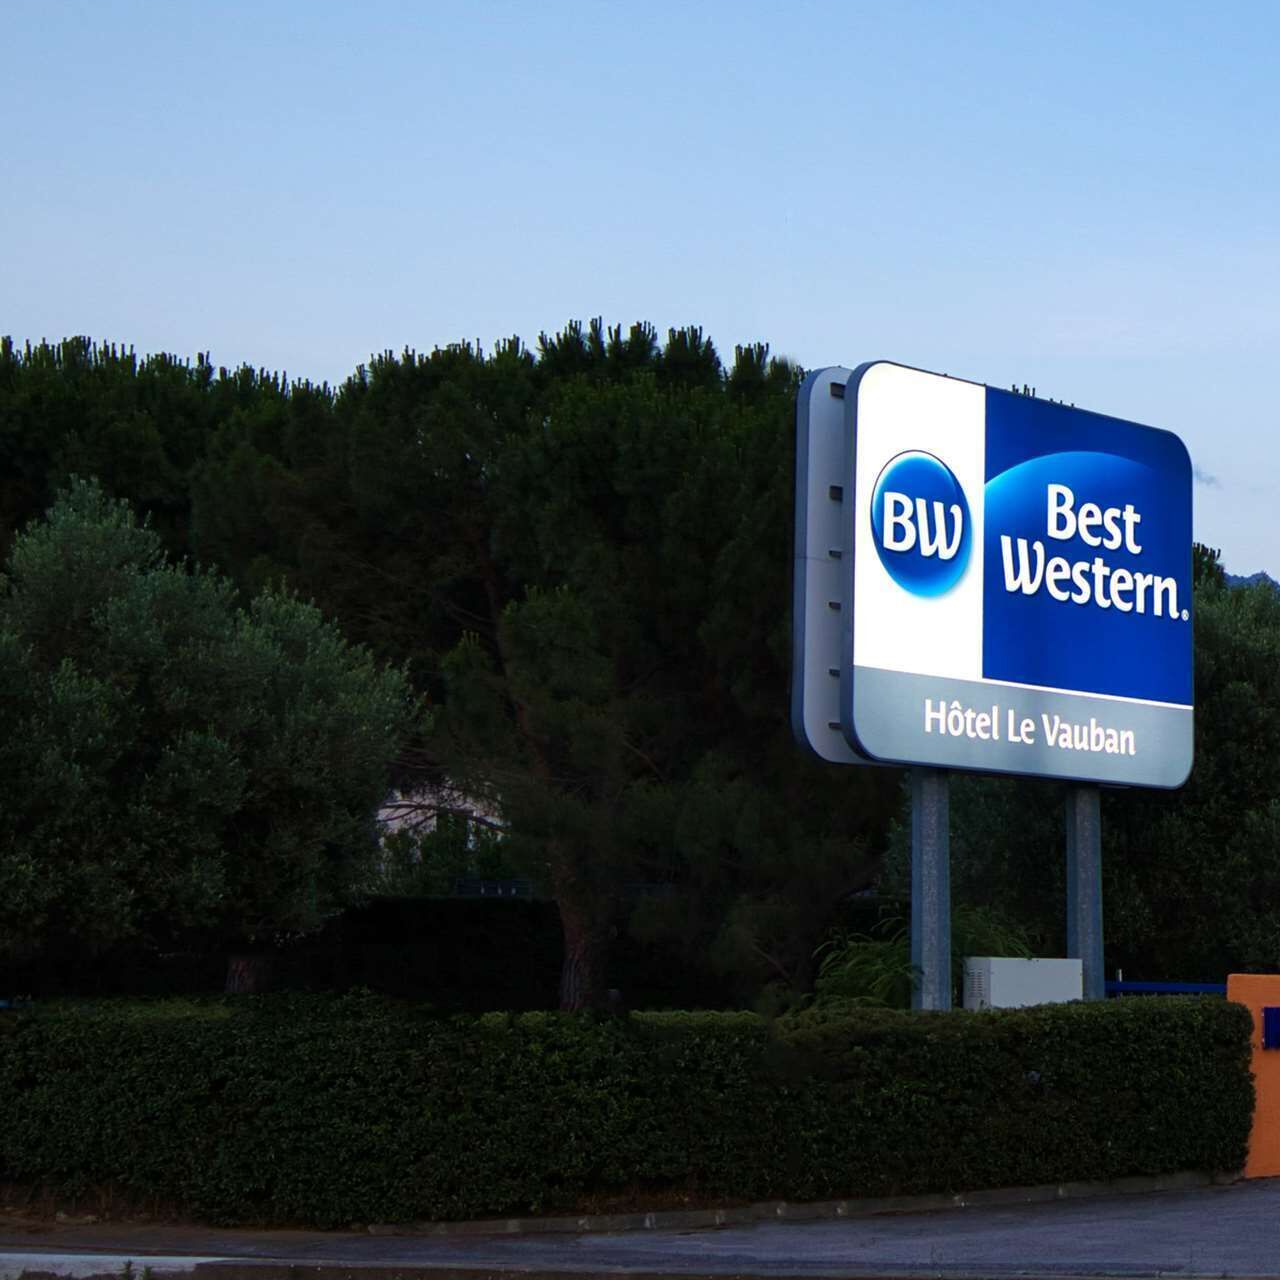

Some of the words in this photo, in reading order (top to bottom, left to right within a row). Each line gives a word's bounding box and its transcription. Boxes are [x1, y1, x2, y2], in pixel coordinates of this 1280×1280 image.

[882, 491, 963, 560] BW
[1047, 483, 1142, 554] Best
[924, 699, 999, 740] Hôtel
[1007, 709, 1035, 744] Le
[1041, 713, 1136, 756] Vauban
